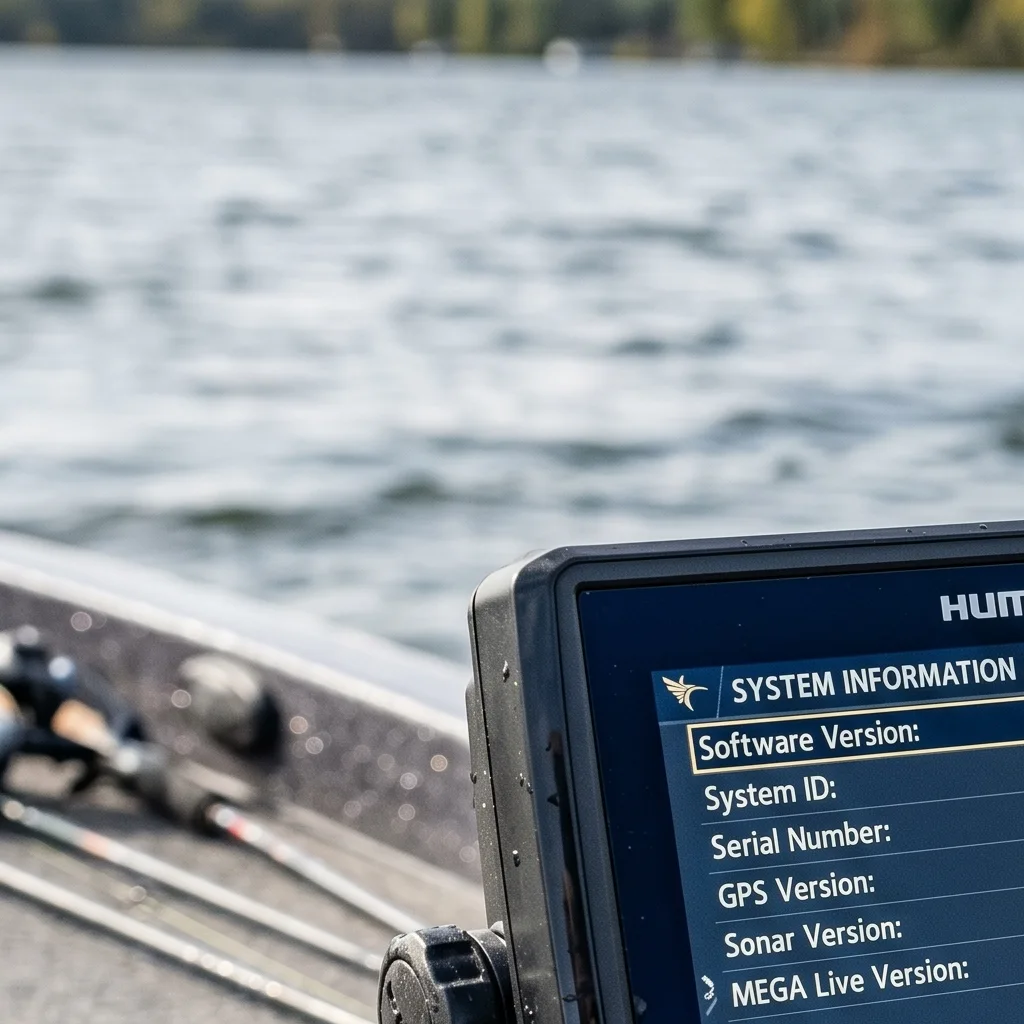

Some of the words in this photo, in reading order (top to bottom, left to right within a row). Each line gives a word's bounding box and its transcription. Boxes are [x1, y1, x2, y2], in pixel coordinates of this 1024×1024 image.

[732, 672, 835, 703] SYSTEM
[843, 657, 1016, 694] INFORMATION
[699, 726, 813, 760] Software
[821, 720, 919, 749] Version:
[705, 782, 796, 816] System
[804, 776, 836, 801] ID:
[712, 828, 779, 859] Serial
[788, 821, 890, 851] Number:
[719, 880, 767, 908] GPS
[775, 872, 874, 901] Version:
[725, 927, 794, 957] Sonar
[803, 918, 902, 948] Version:
[732, 974, 807, 1007] MEGA
[815, 967, 864, 997] Live
[872, 960, 970, 990] Version:
